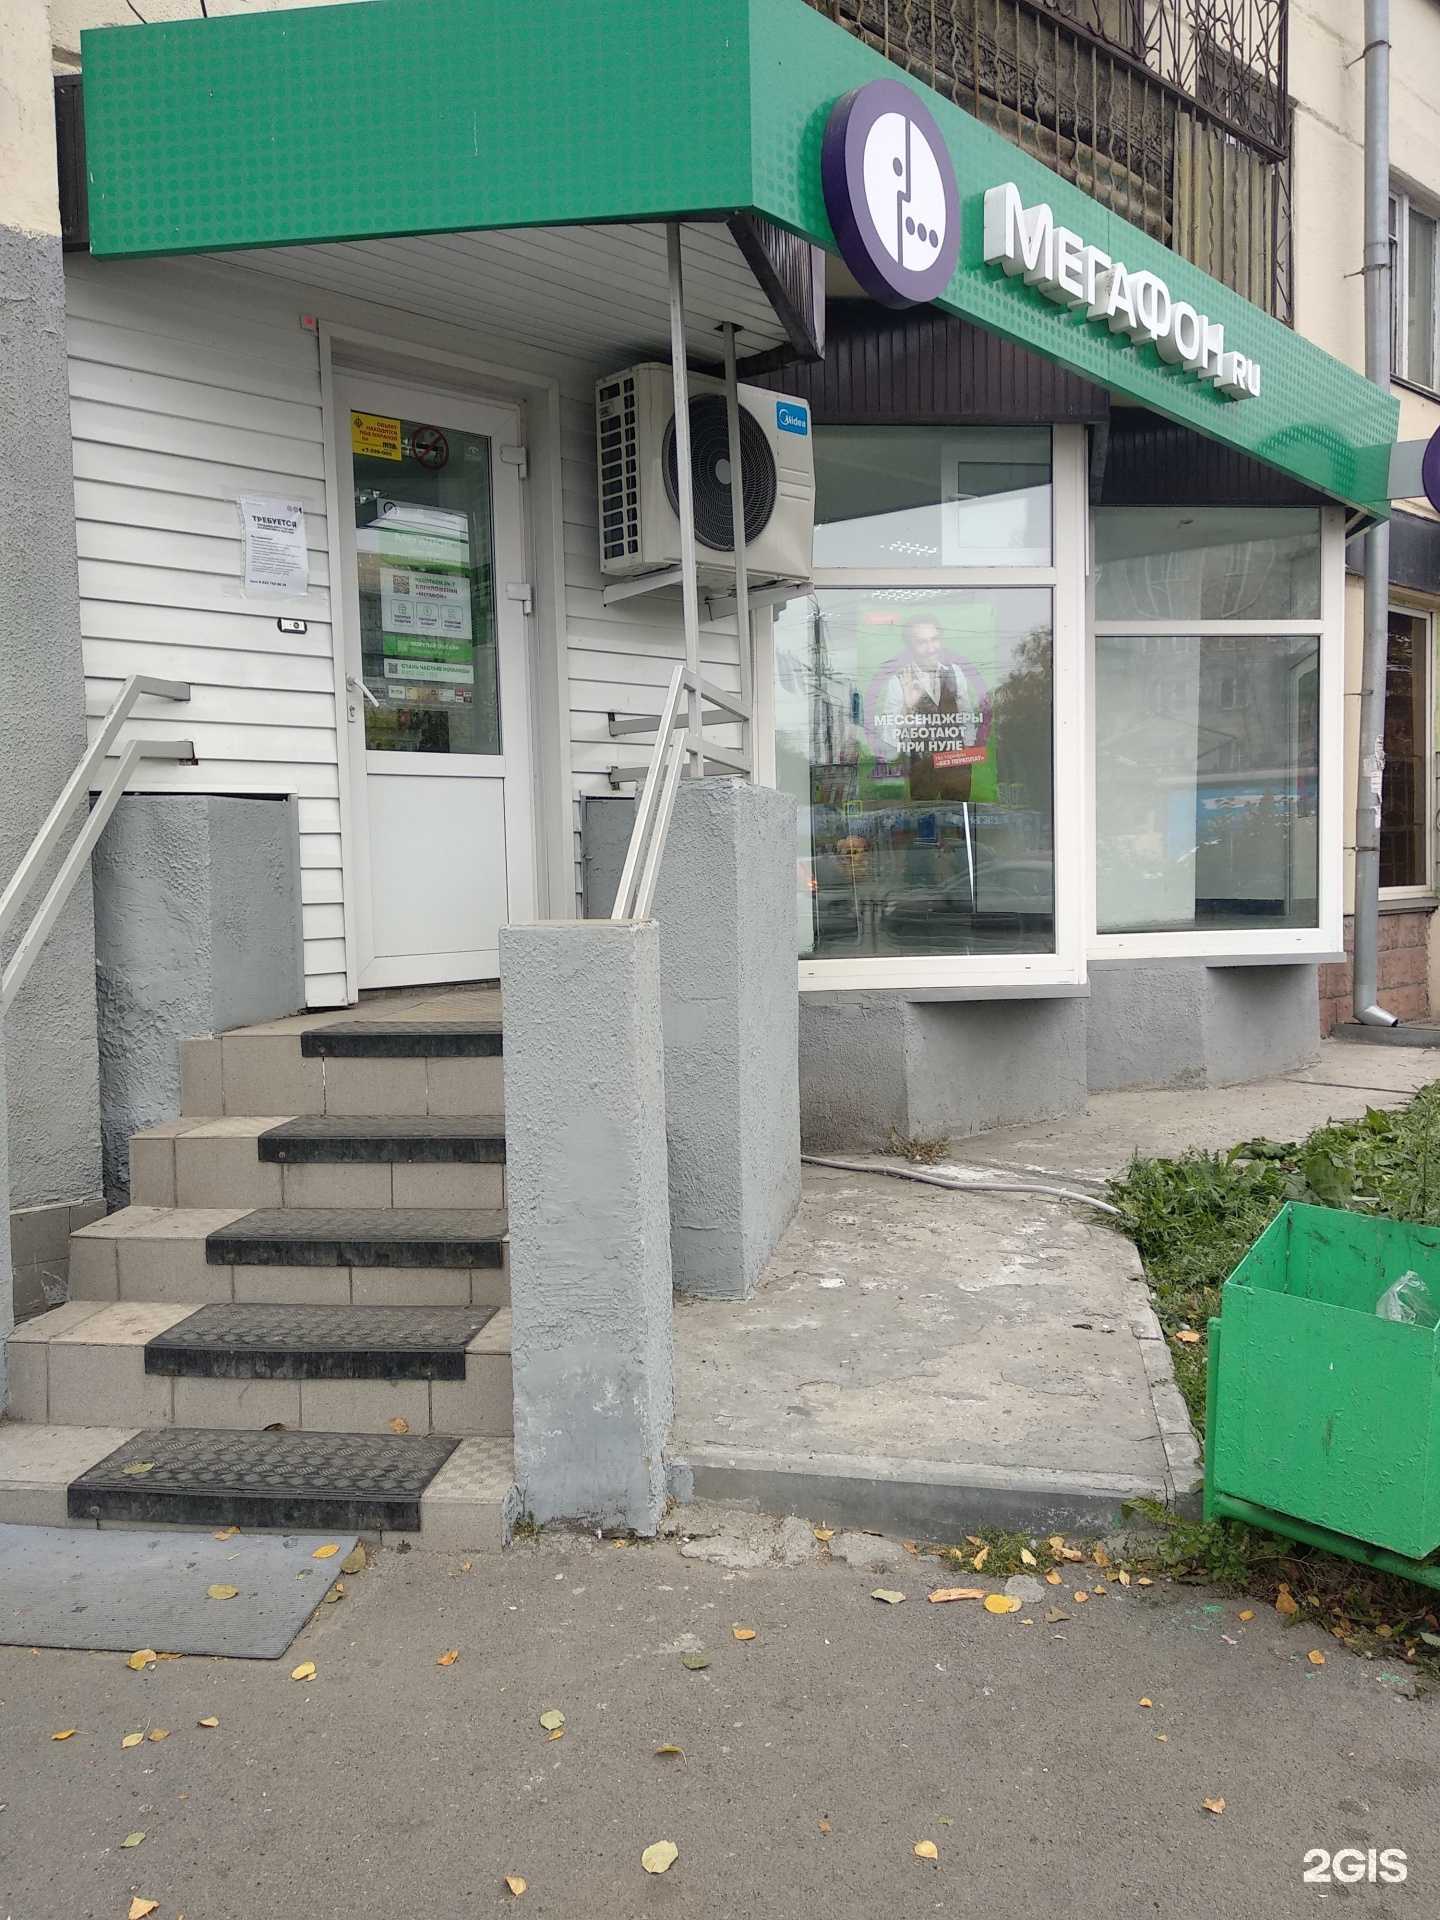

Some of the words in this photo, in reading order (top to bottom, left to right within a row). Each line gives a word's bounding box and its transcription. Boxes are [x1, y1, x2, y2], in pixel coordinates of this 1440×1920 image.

[984, 181, 1224, 379] МЕГАФОН
[784, 414, 806, 427] Midea
[251, 515, 297, 528] ТРЕБУЕТСЯ
[874, 712, 984, 726] МЕССЕНДЖЕРЫ
[894, 726, 967, 739] РАБОТАЮТ
[896, 741, 925, 753] ПРИ
[928, 740, 963, 752] НУЛЕ
